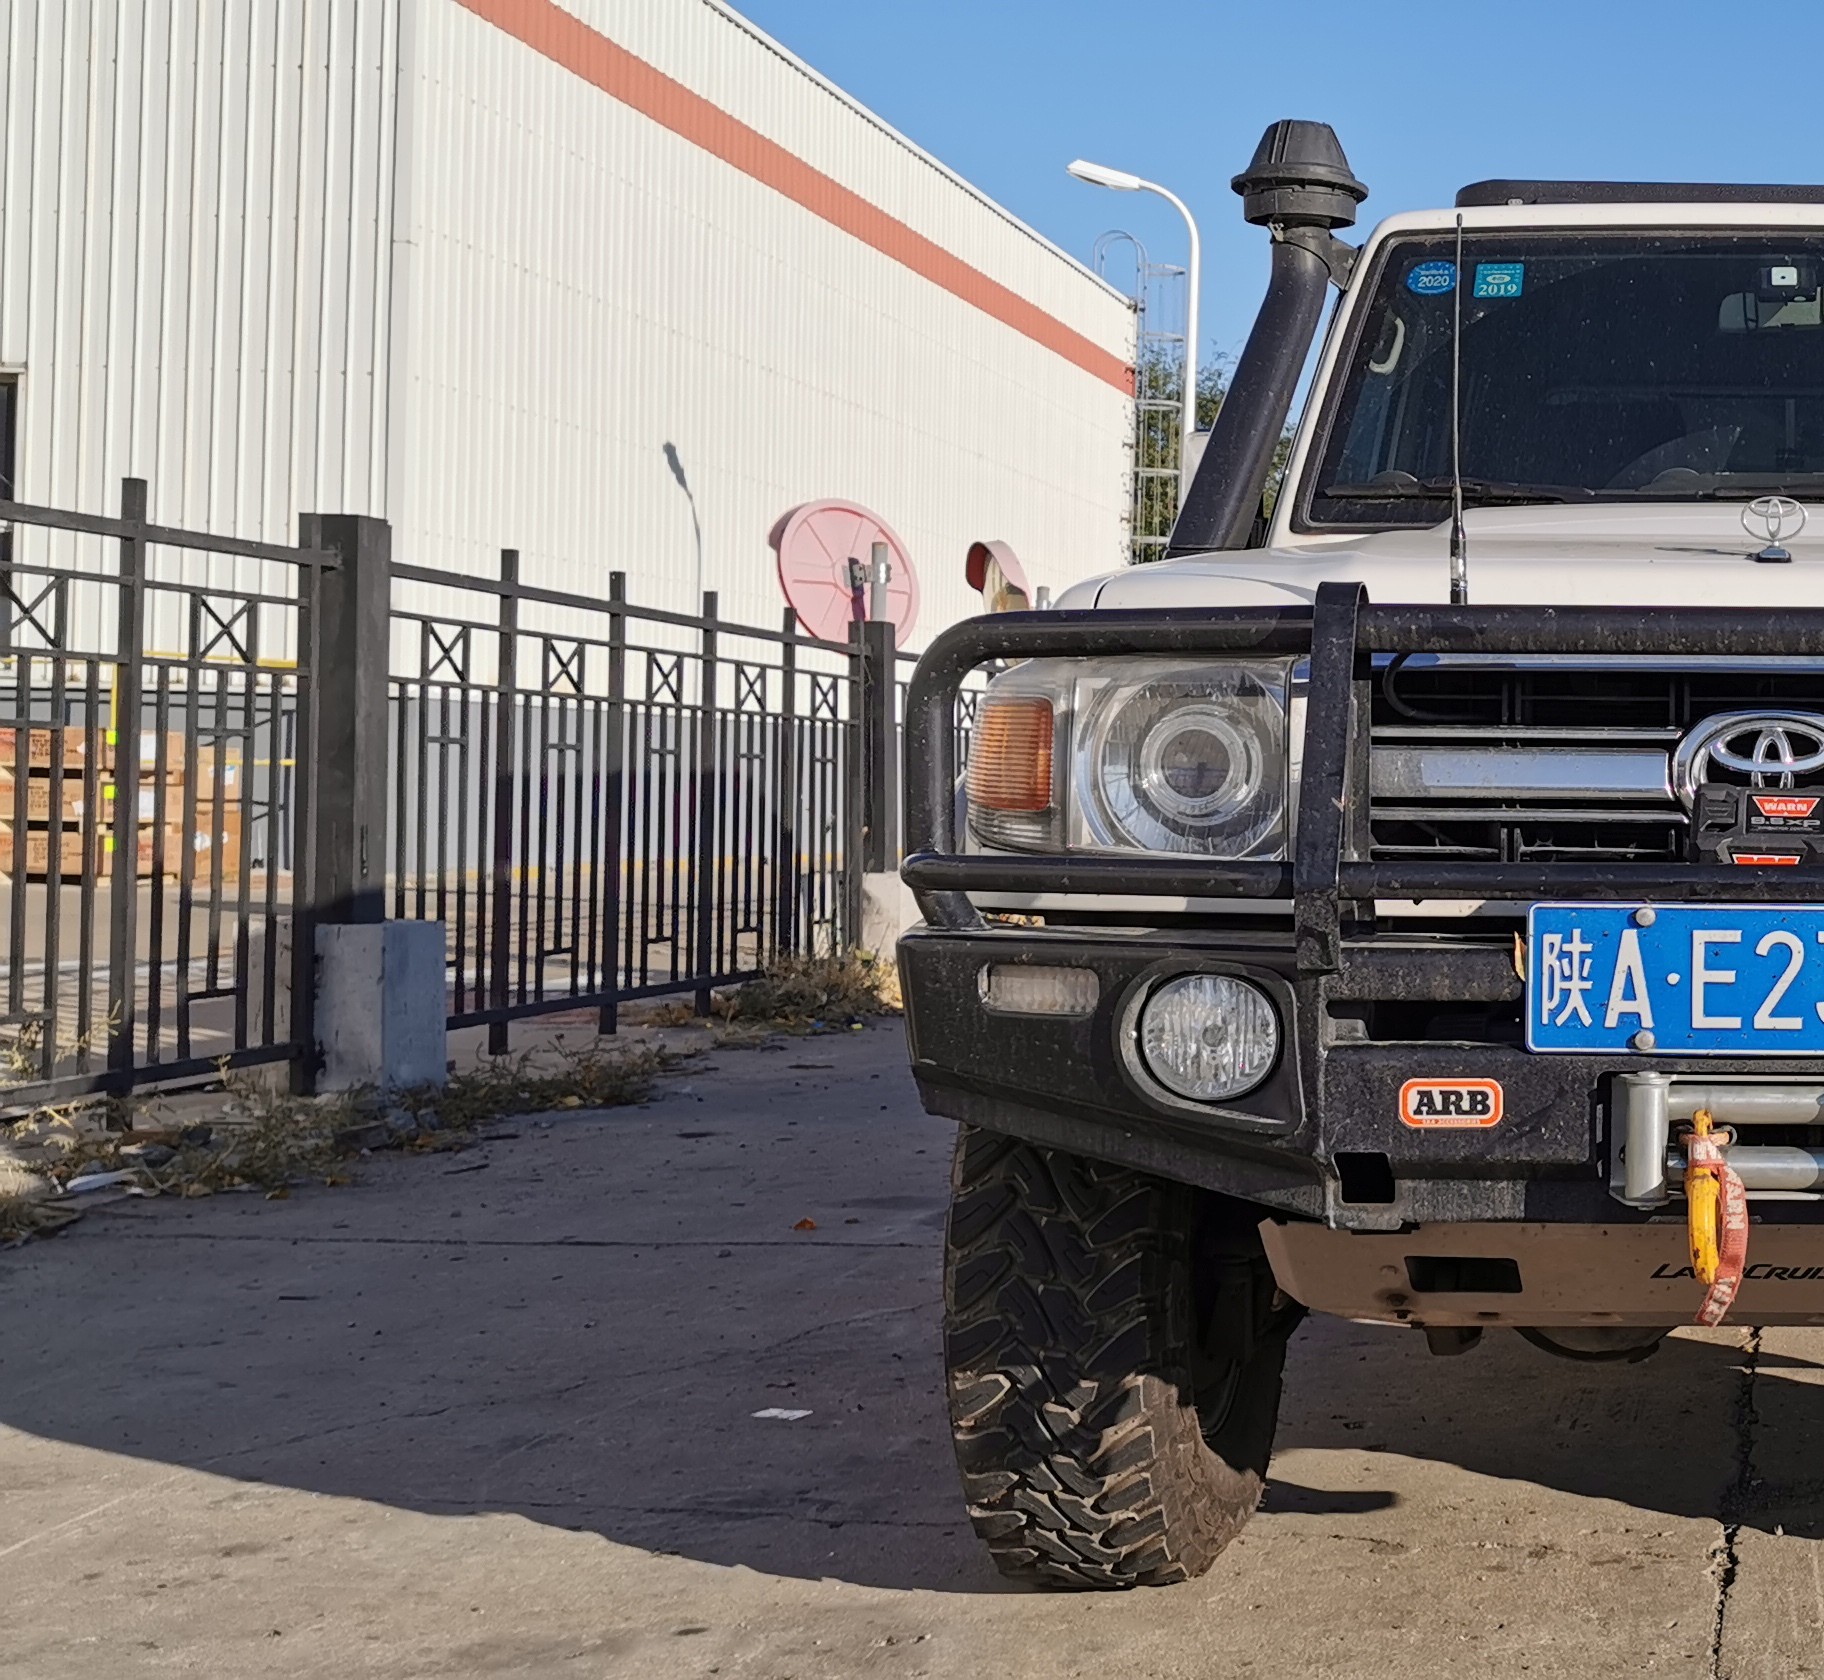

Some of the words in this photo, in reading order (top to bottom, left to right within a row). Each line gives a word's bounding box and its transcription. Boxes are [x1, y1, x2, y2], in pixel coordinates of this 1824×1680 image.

[1418, 276, 1449, 287] 2020
[1479, 284, 1517, 295] 2019
[1763, 801, 1808, 812] WARN
[1413, 1089, 1491, 1116] ARB
